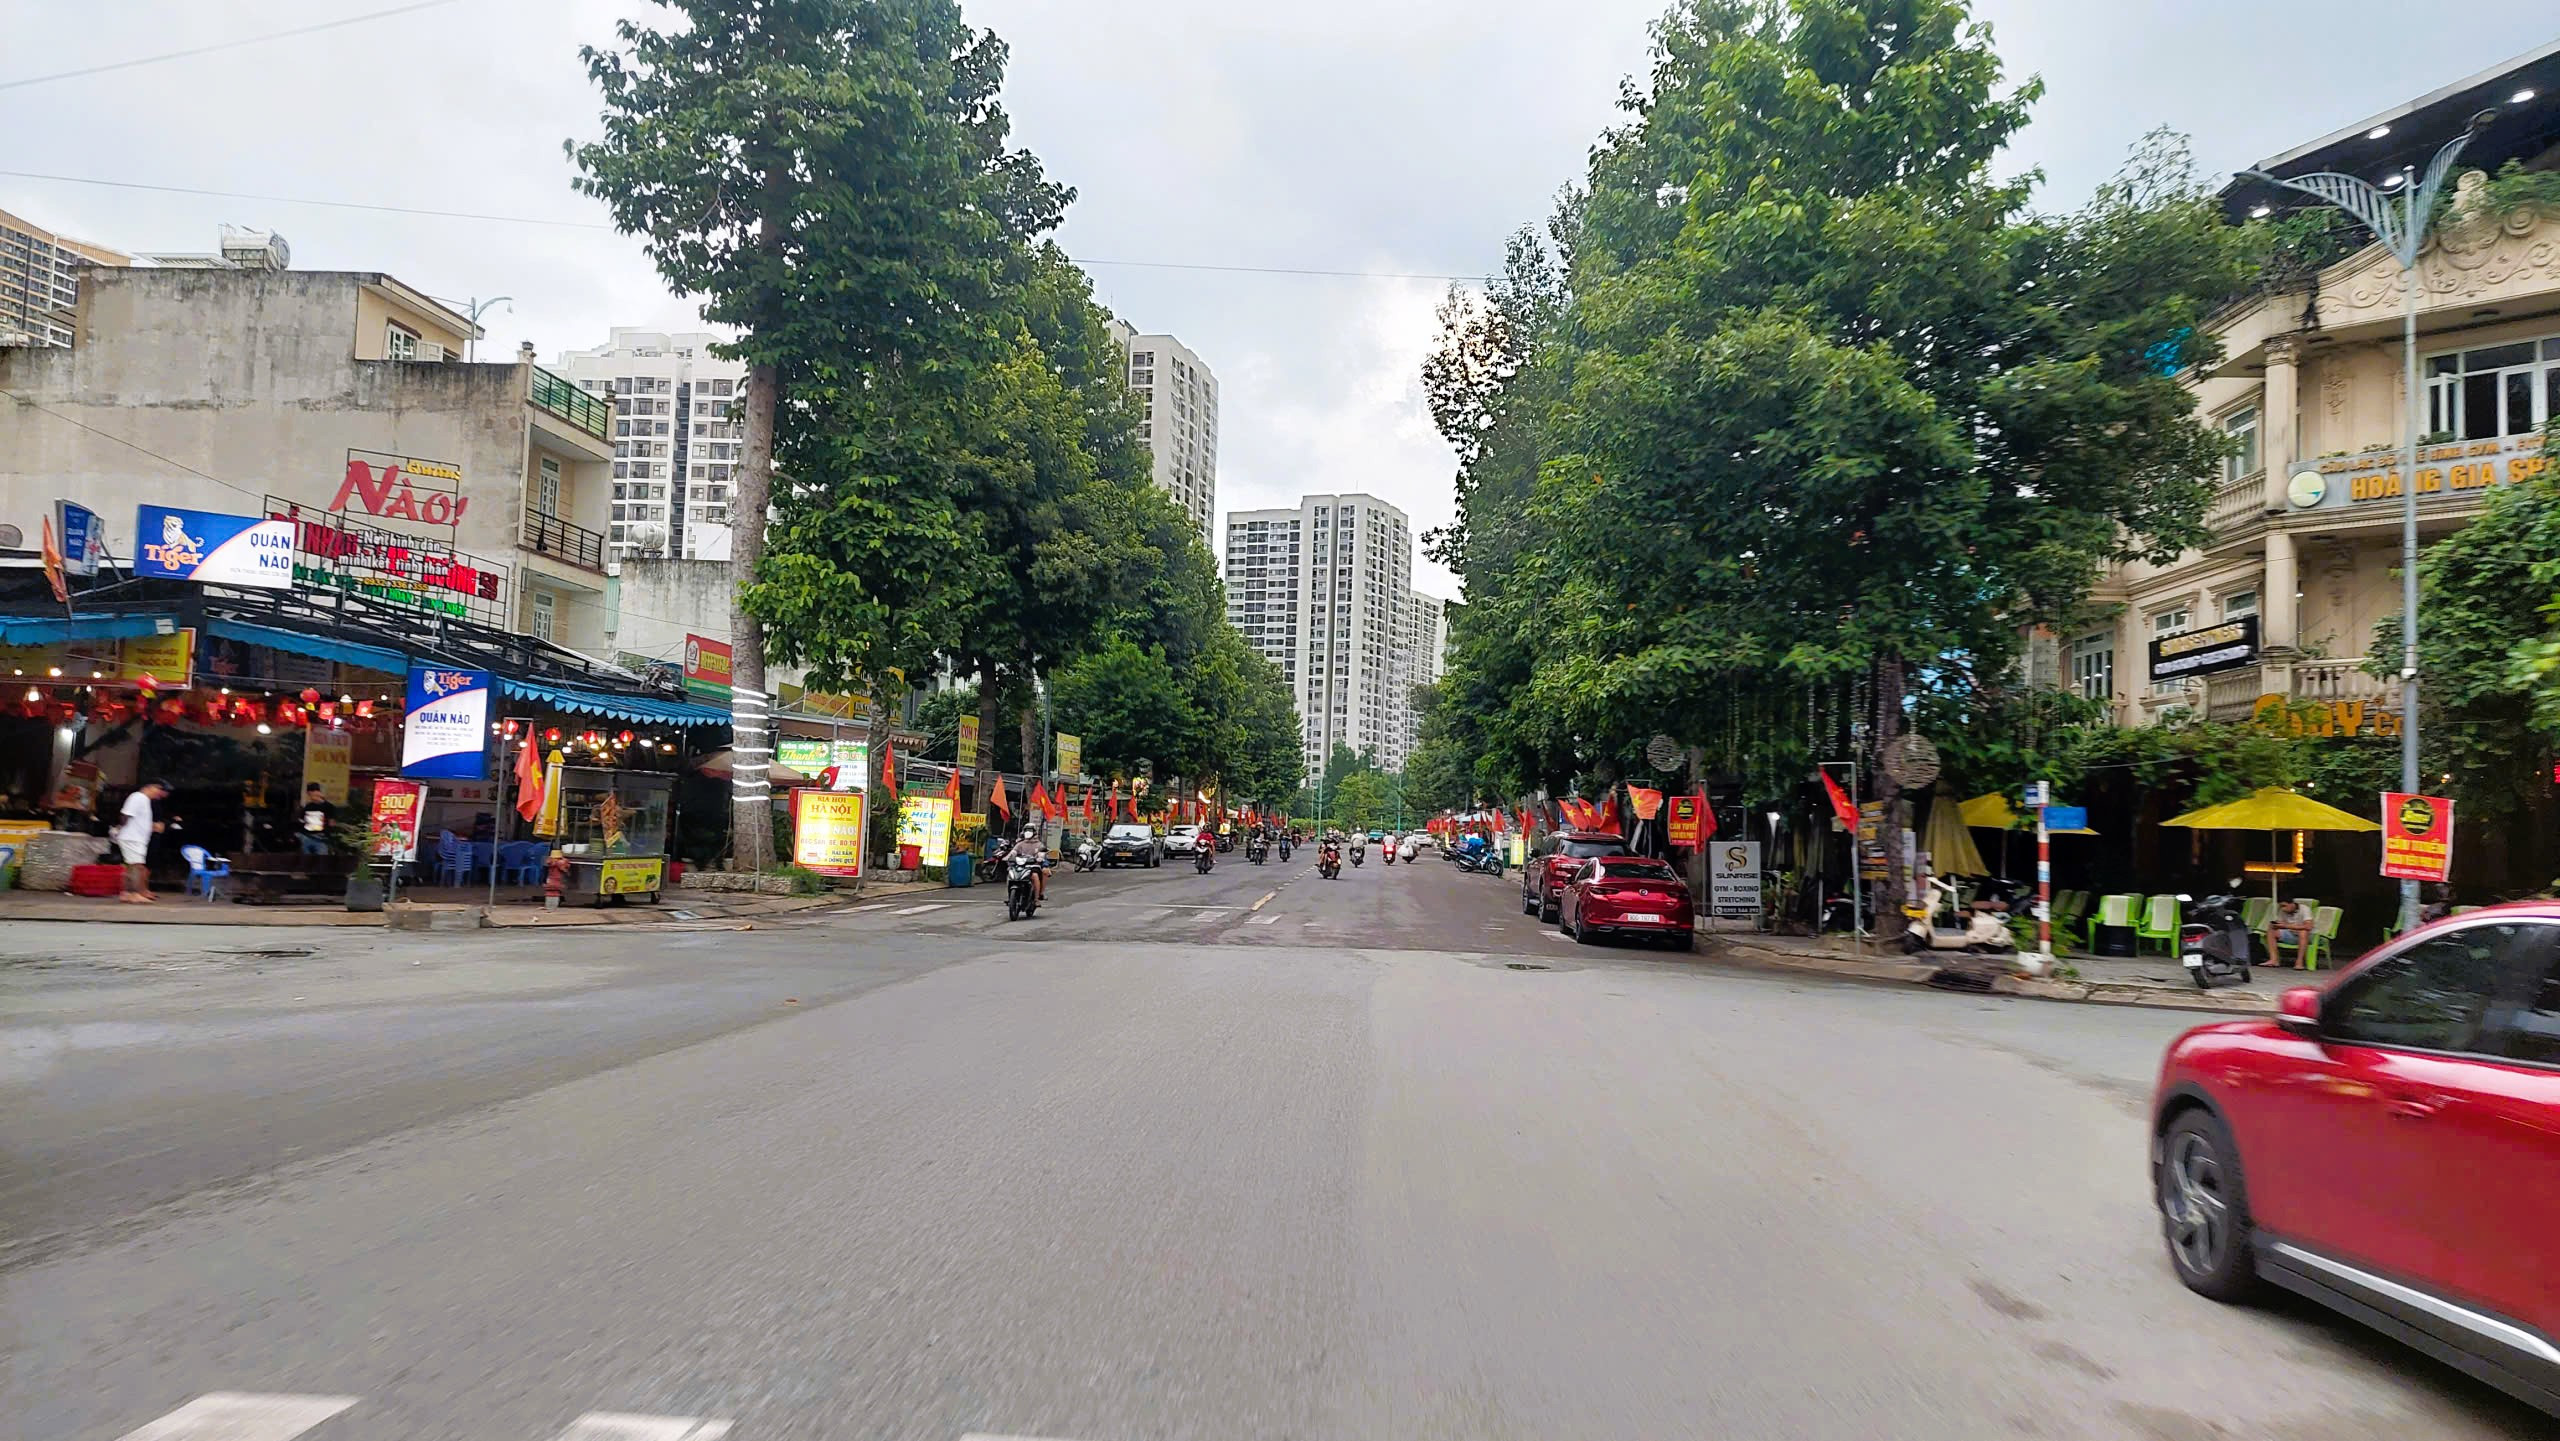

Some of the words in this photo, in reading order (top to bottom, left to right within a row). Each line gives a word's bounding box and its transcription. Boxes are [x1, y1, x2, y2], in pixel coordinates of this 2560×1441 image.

[2450, 463, 2497, 489] GIA
[144, 543, 205, 571] Tiger
[438, 671, 474, 690] Tiger
[830, 803, 852, 815] NỘI
[1717, 896, 1756, 904] STRETCHING
